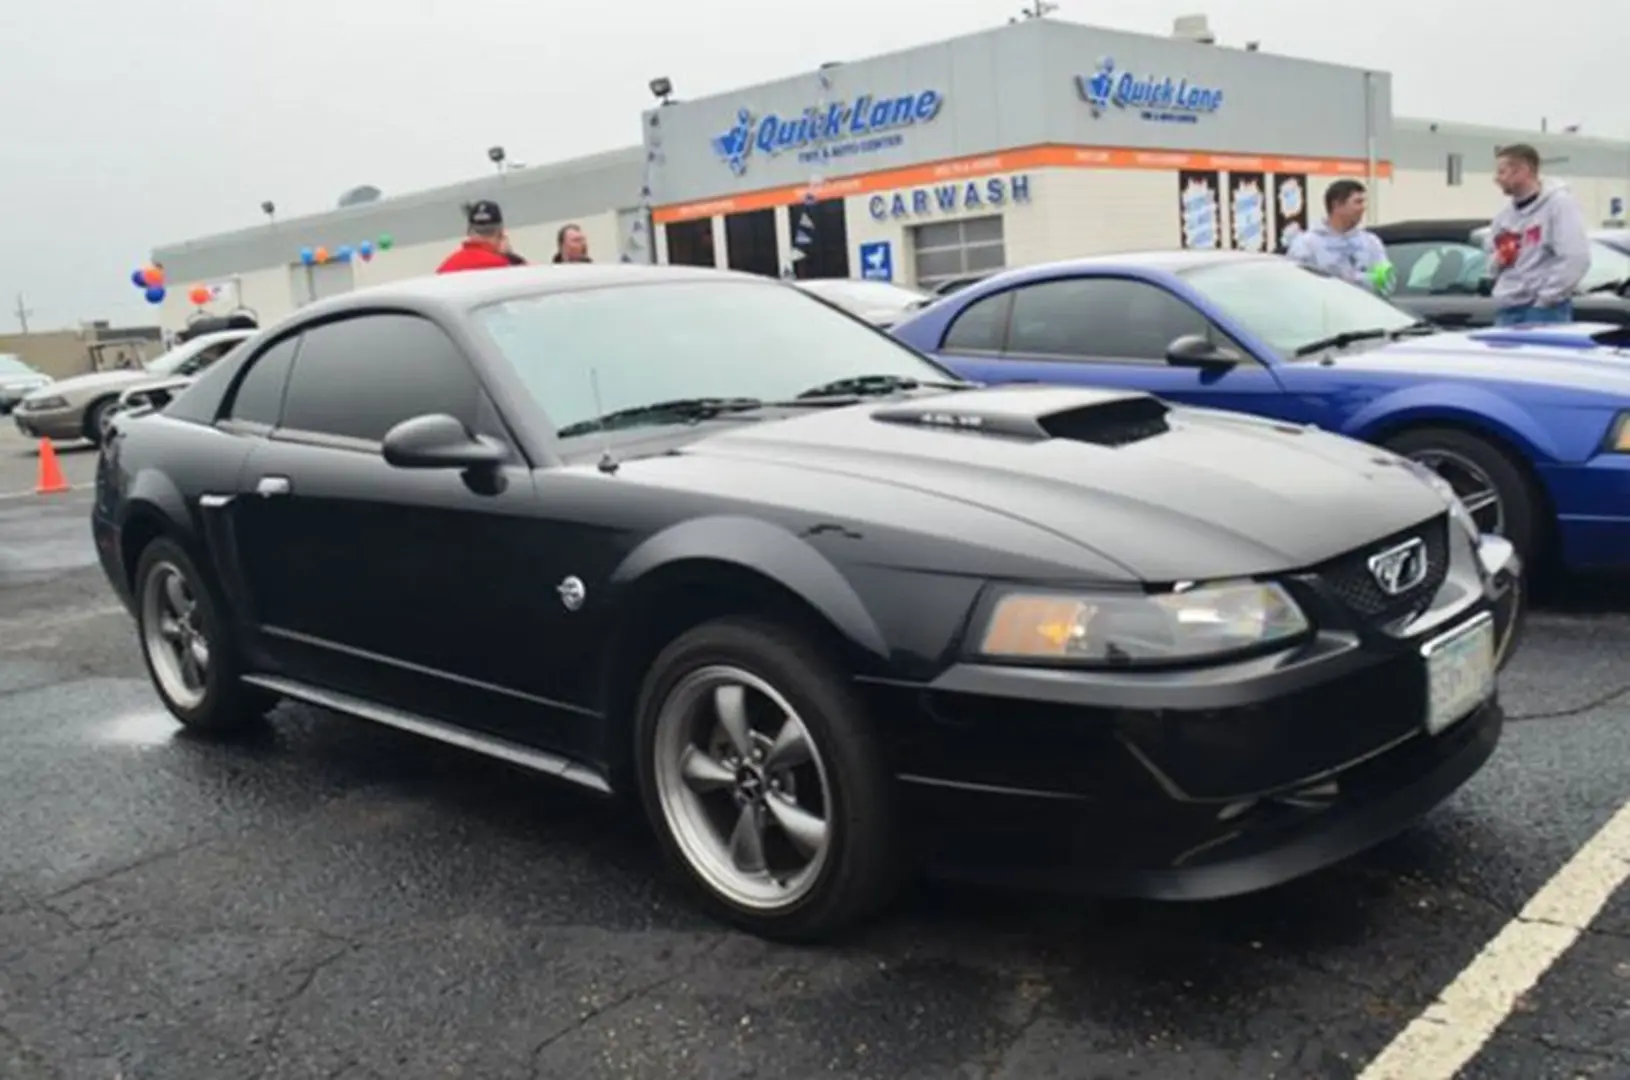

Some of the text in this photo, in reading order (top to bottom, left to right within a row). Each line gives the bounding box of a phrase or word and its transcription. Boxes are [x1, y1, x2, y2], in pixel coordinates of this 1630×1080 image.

[1118, 72, 1223, 110] Quick Lane
[756, 89, 940, 151] Quick Lane
[868, 174, 1030, 220] CARWASH
